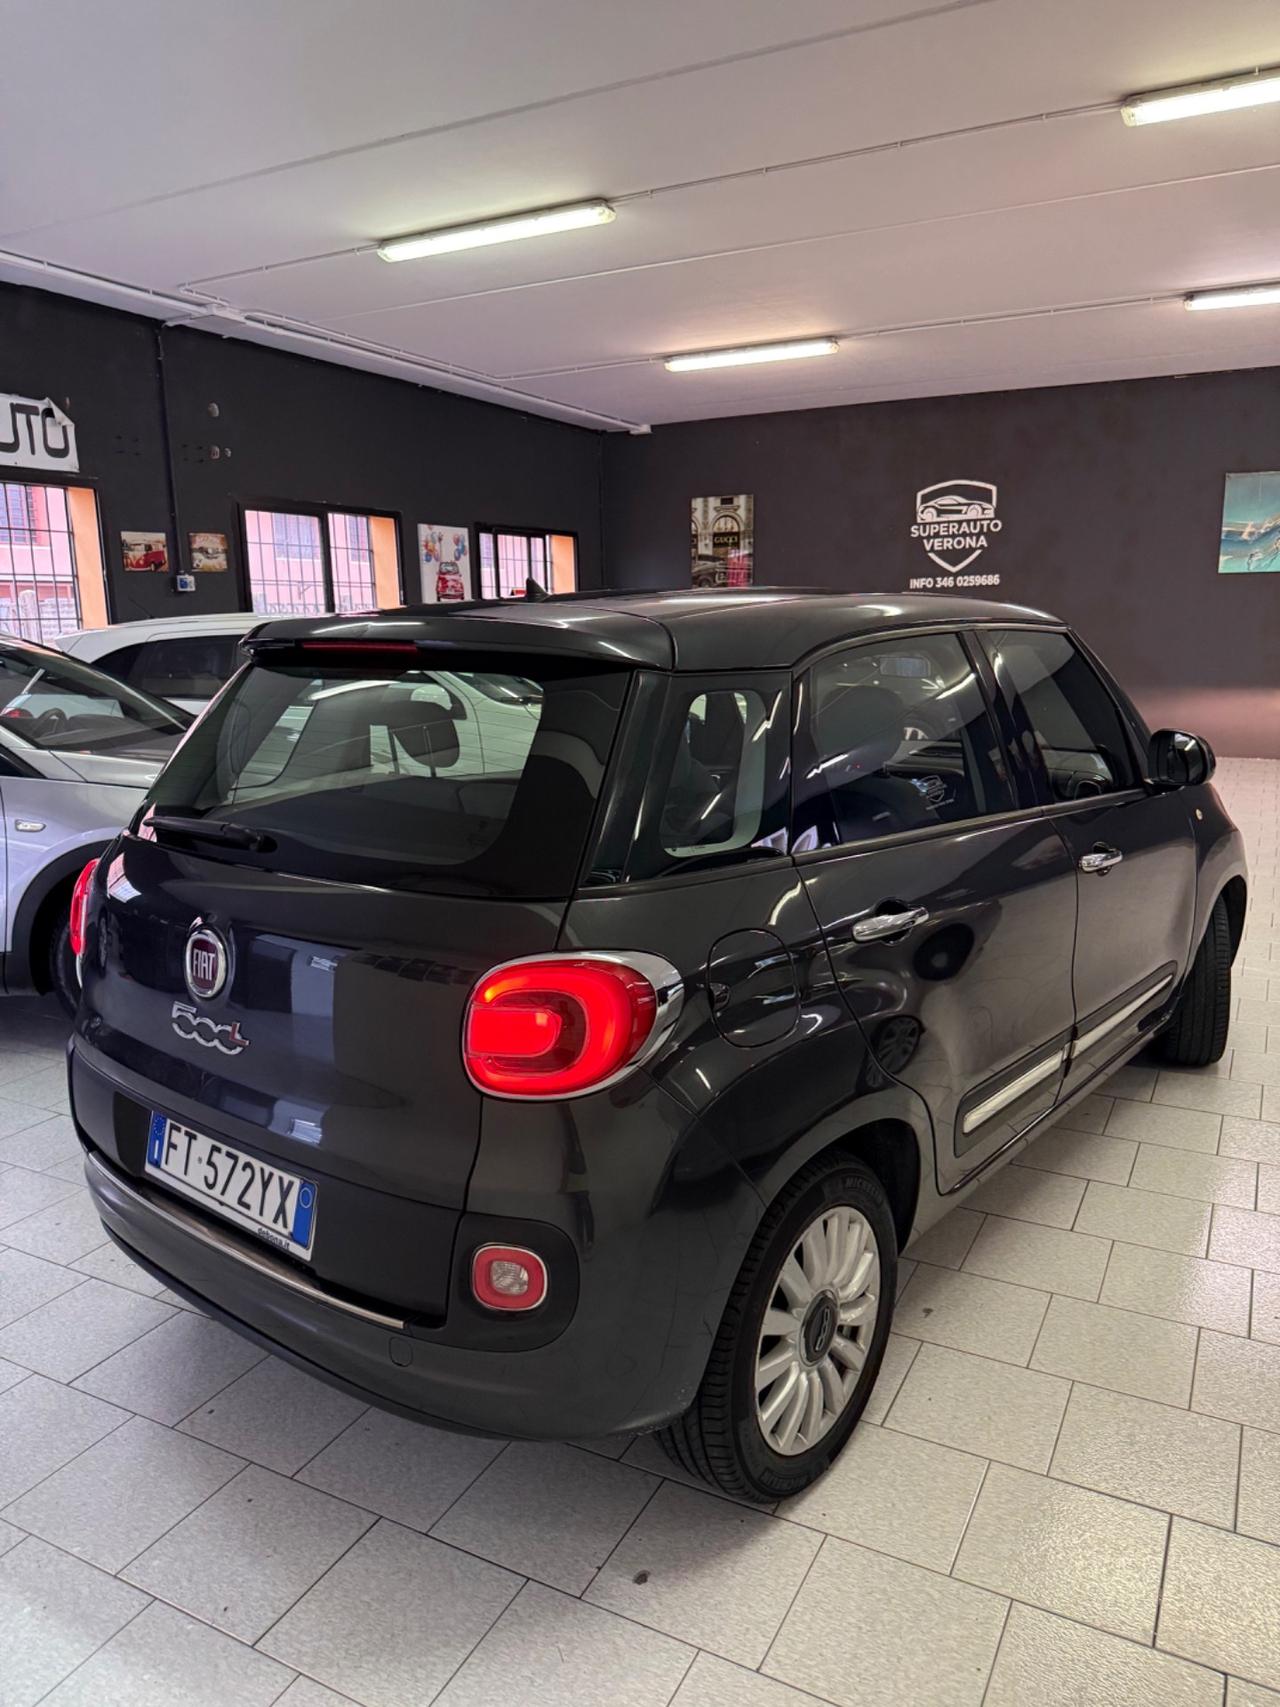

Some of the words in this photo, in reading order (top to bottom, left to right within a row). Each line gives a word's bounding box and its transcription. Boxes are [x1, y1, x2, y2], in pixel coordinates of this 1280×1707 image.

[910, 519, 1002, 538] SUPERAUTO
[922, 535, 988, 551] VERONA
[909, 578, 934, 589] INFO
[935, 576, 955, 588] 346
[956, 574, 1001, 587] 0259686
[192, 948, 215, 981] FIAT
